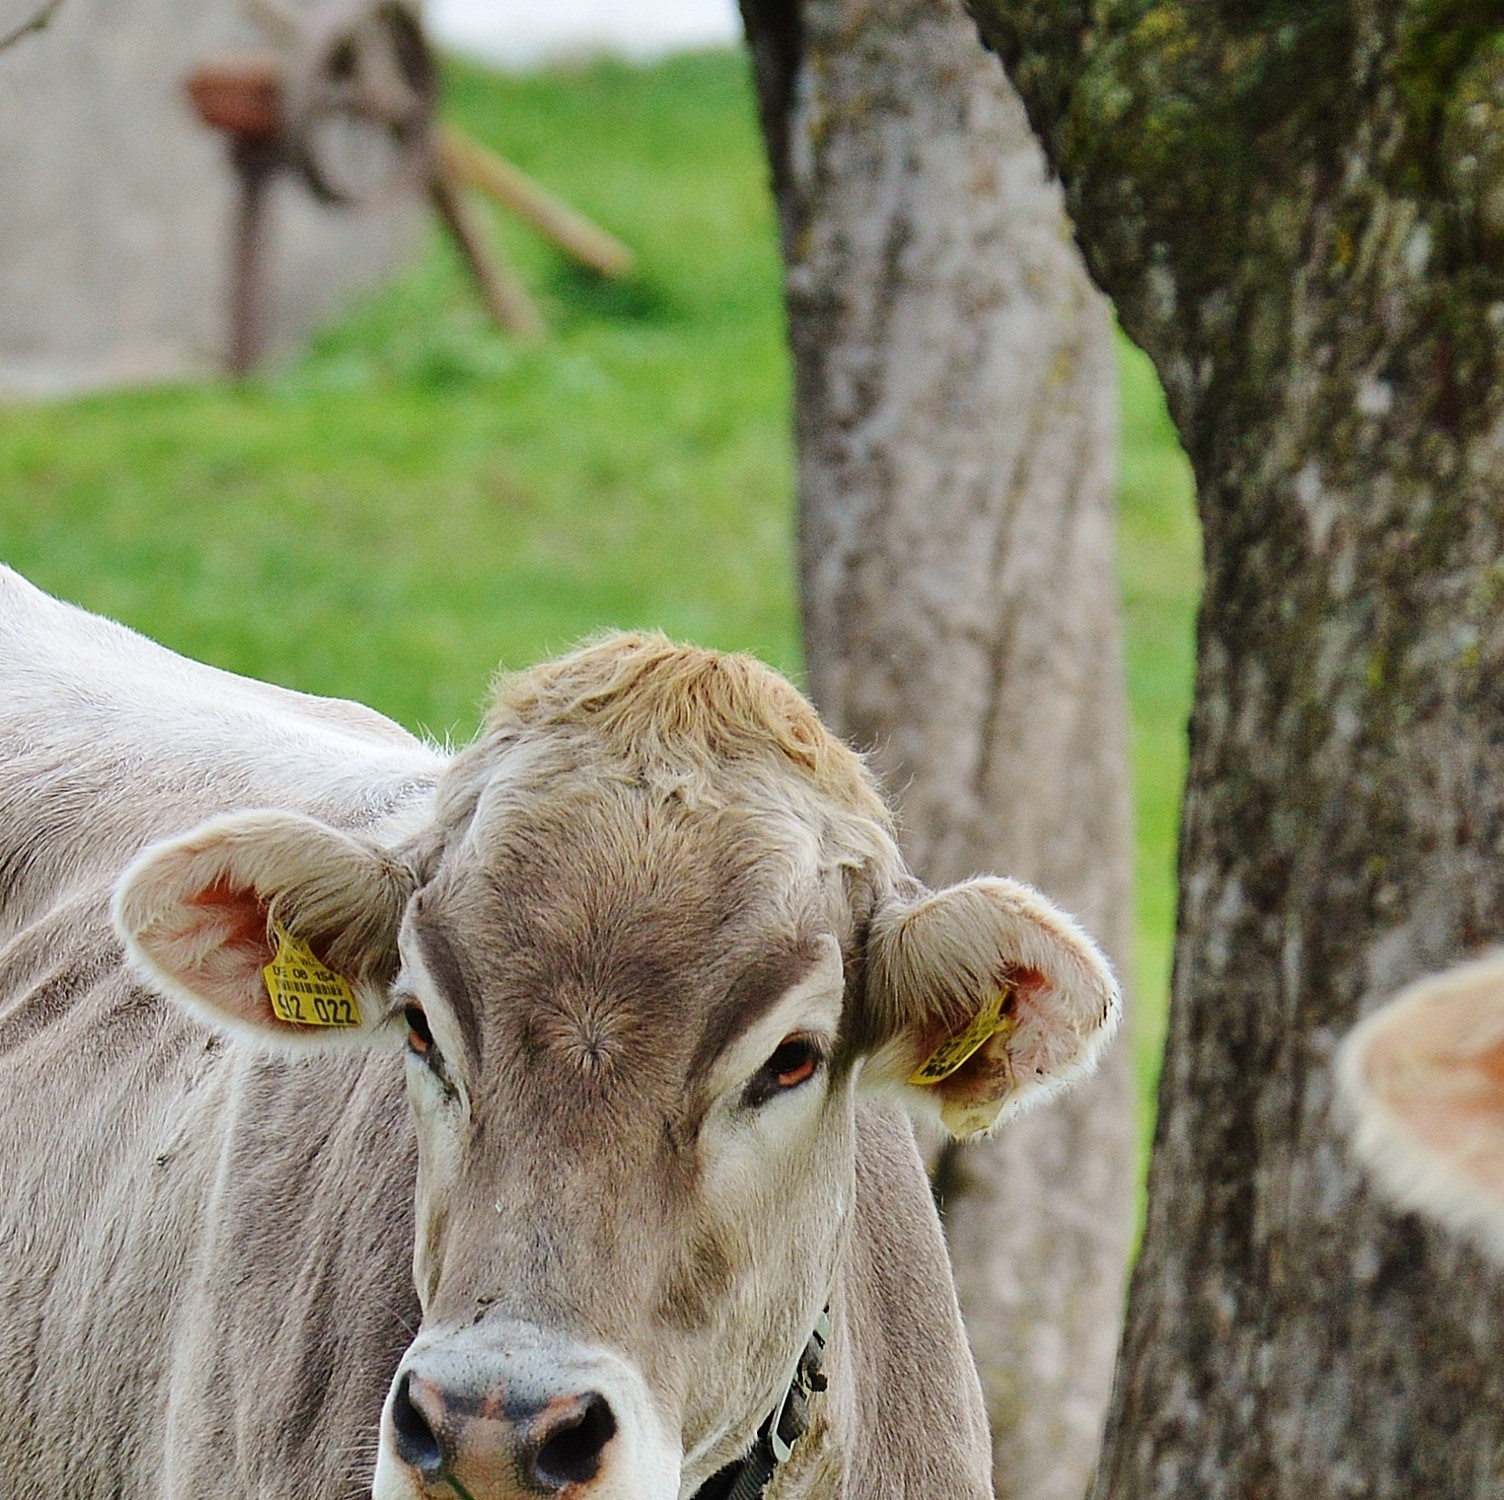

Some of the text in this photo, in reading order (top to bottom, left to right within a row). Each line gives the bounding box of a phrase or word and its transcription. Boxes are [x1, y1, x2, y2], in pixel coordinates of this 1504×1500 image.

[292, 968, 309, 980] 08
[313, 970, 336, 982] 154
[277, 993, 358, 1024] 92 022
